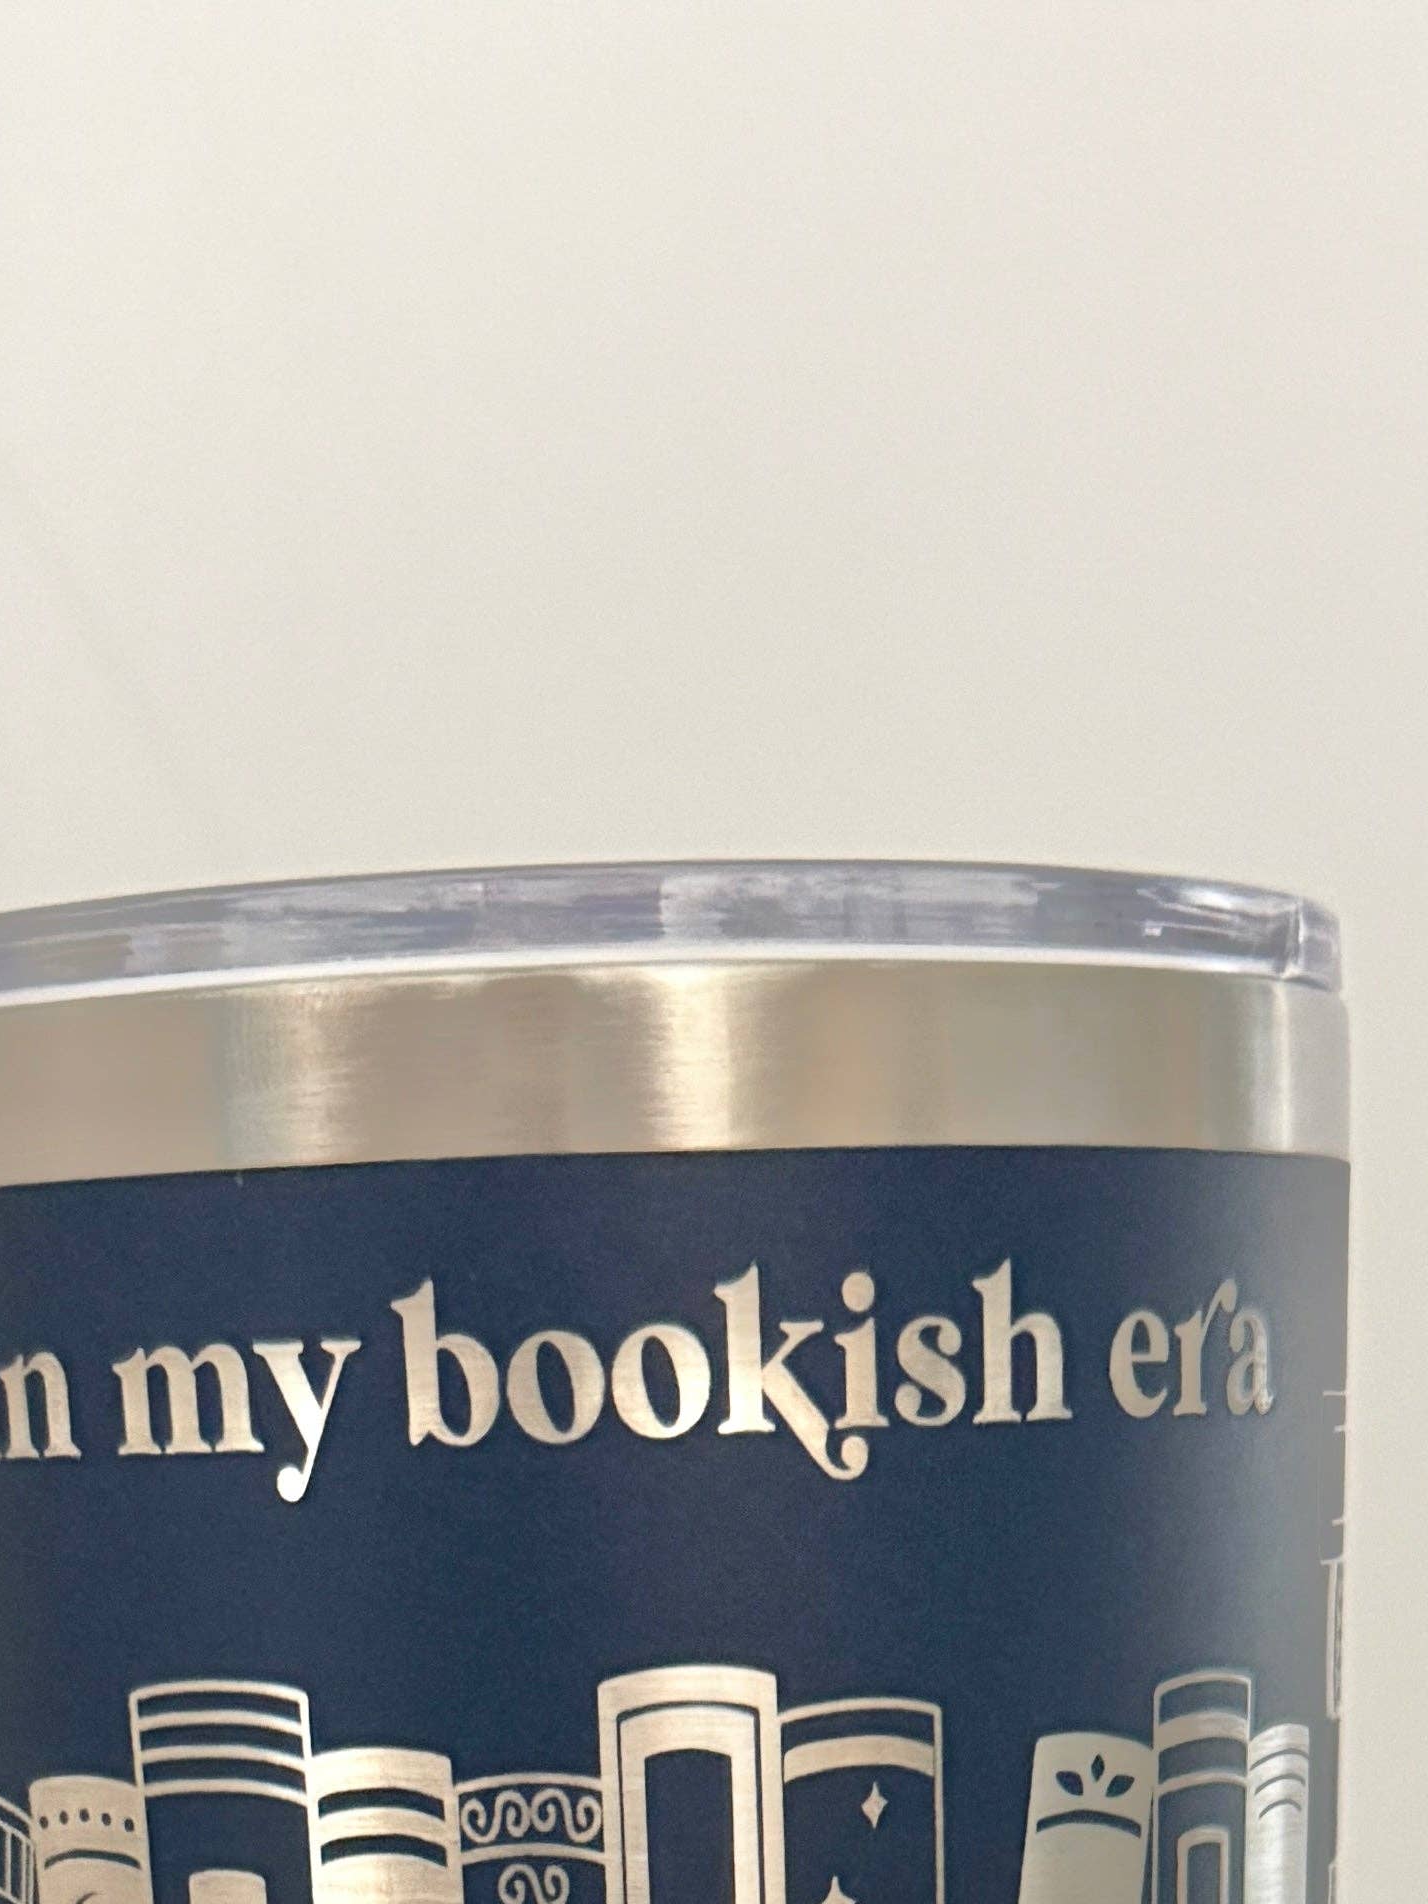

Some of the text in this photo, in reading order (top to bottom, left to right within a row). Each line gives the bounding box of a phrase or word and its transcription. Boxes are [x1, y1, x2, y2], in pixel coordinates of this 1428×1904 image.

[112, 1341, 362, 1502] my
[390, 1258, 1073, 1480] bookish
[1109, 1277, 1273, 1419] era
